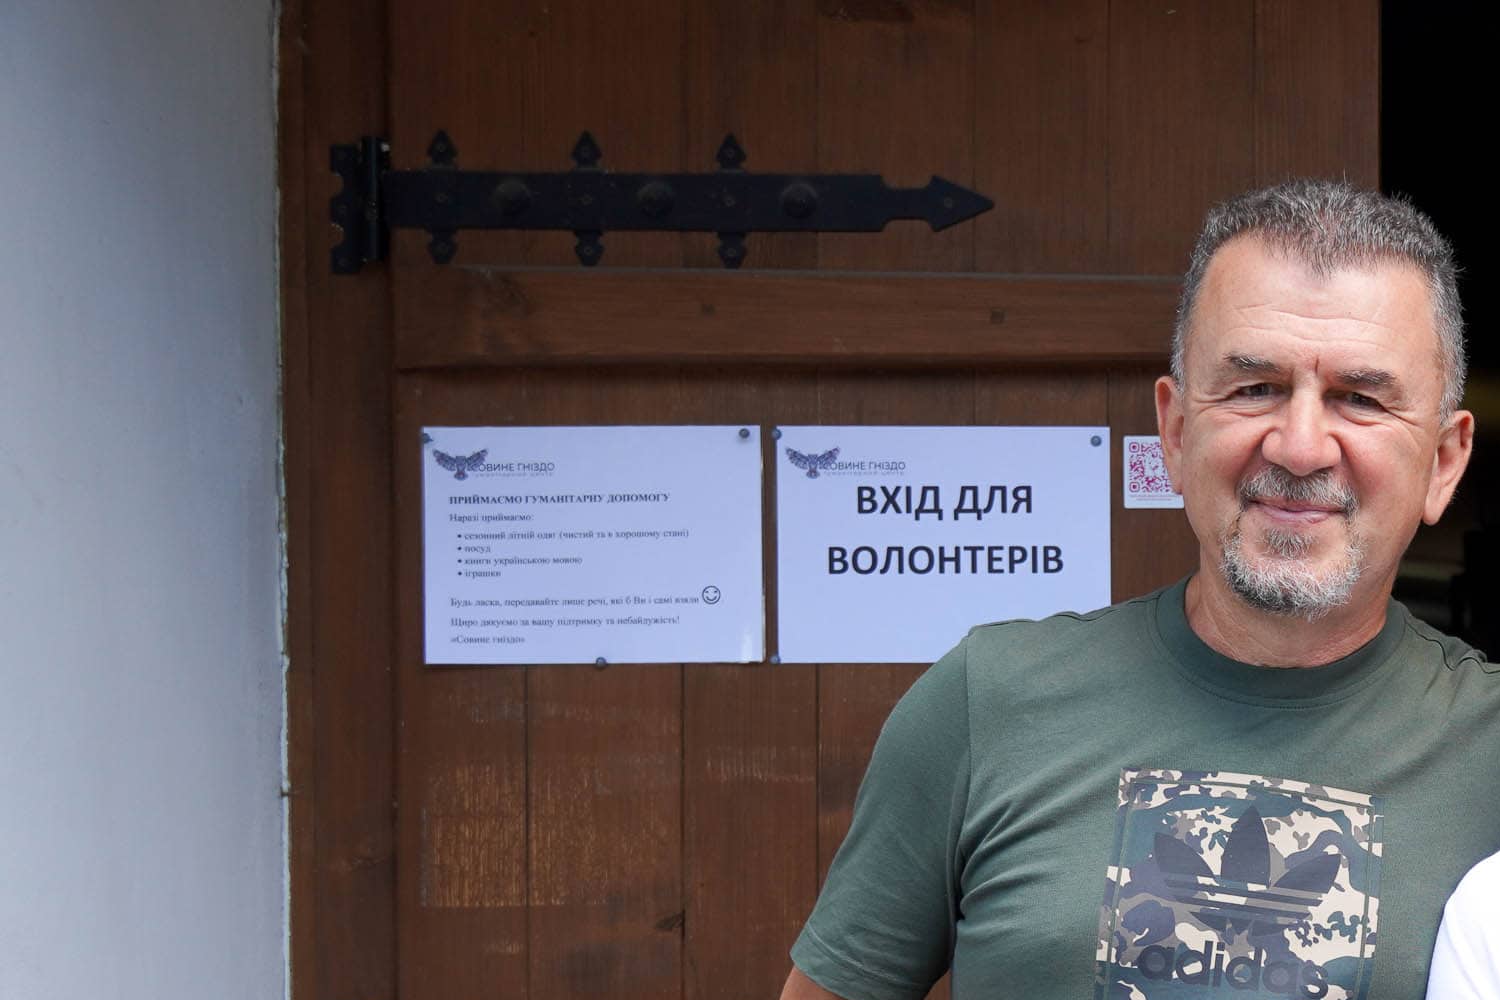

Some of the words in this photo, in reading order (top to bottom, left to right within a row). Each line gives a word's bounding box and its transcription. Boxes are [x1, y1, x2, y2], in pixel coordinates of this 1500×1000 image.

[517, 462, 556, 472] ГНІЗДО
[869, 461, 906, 471] ГНІЗДО
[449, 494, 523, 505] ПРИЙМАЄМО
[525, 494, 603, 504] ГУМАНІТАРНУ
[607, 493, 670, 504] ДОПОМОГУ
[857, 485, 943, 521] ВХІД
[953, 485, 1033, 520] ДЛЯ
[828, 545, 1064, 575] ВОЛОНТЕРІВ
[1137, 941, 1329, 999] adidas
